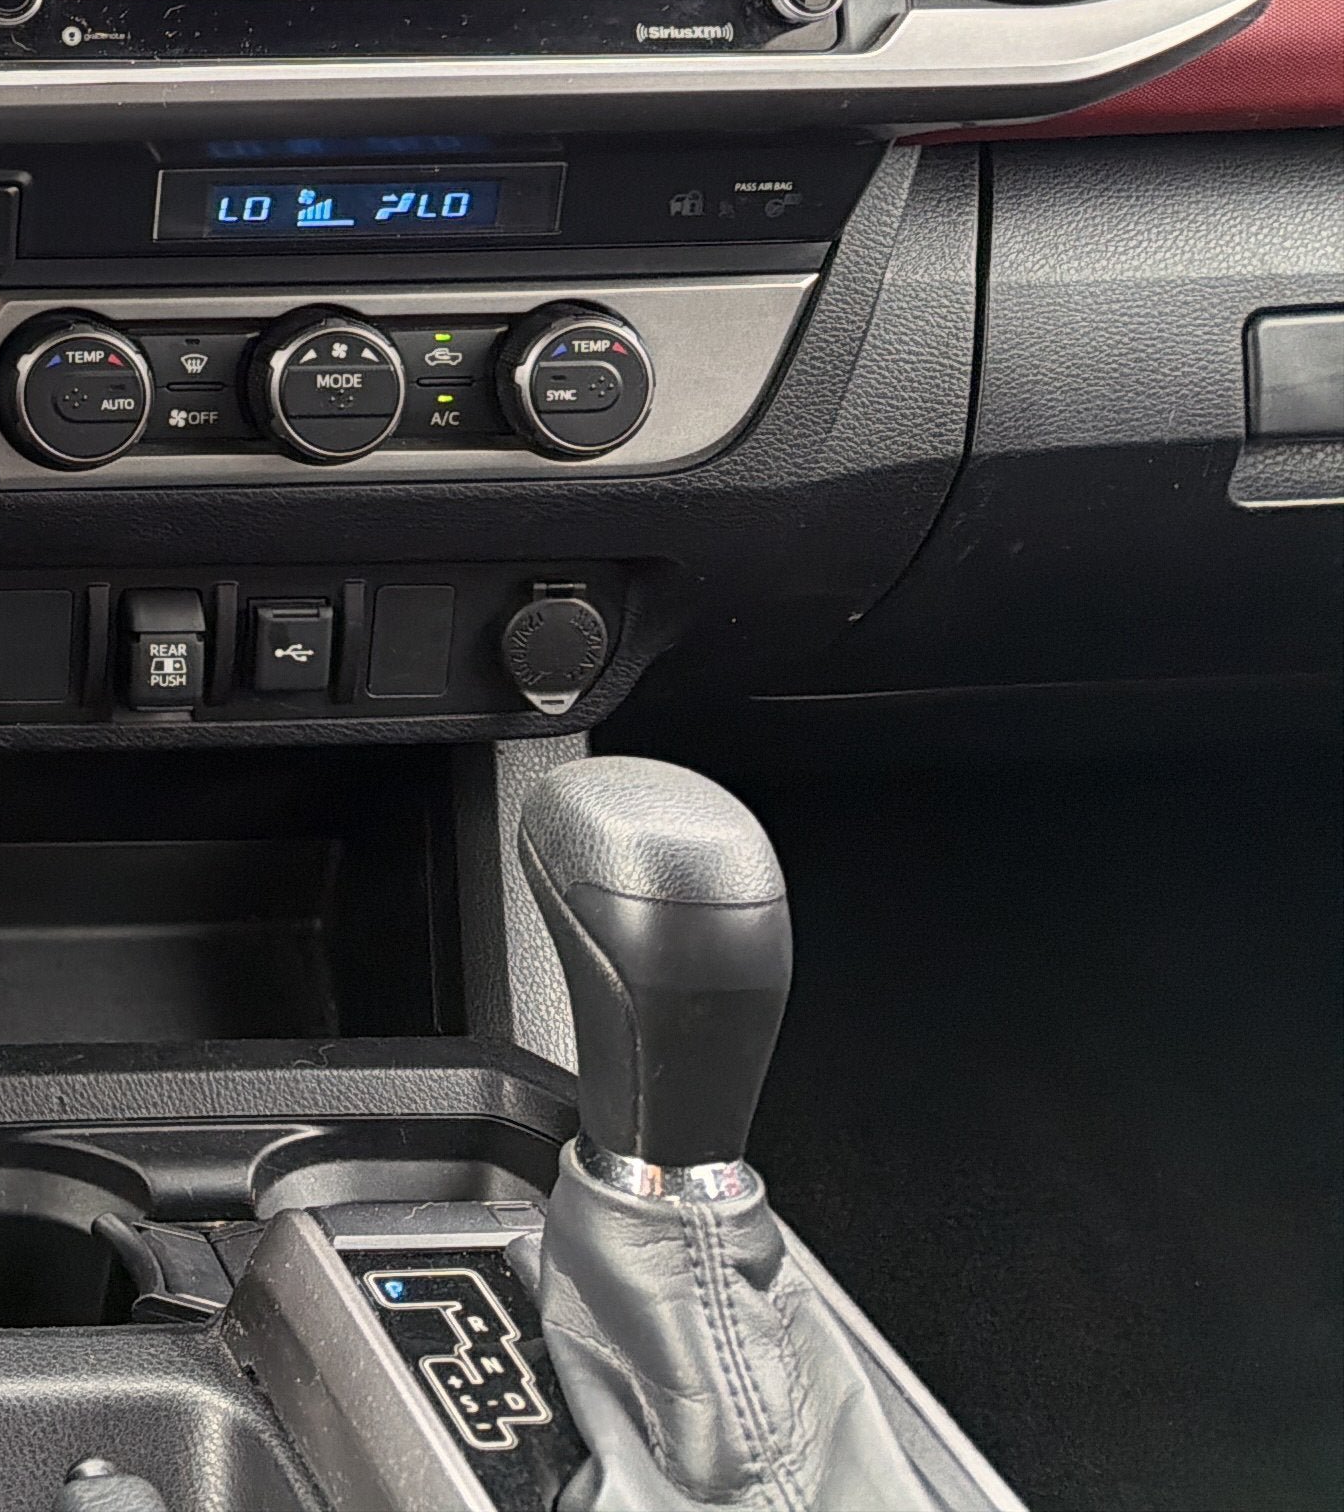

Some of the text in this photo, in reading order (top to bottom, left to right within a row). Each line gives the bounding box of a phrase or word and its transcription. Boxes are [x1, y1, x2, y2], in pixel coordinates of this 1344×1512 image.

[734, 182, 793, 192] PASS AIR BAG
[572, 340, 611, 353] TEMP
[65, 351, 105, 364] TEMP
[316, 373, 363, 389] MODE
[546, 390, 578, 401] SYNC
[100, 399, 135, 411] AUTO
[188, 411, 219, 425] OFF
[430, 411, 460, 427] A/C
[150, 643, 187, 657] REAR
[150, 675, 186, 687] PUSH
[467, 1316, 489, 1332] R
[480, 1357, 504, 1374] N
[459, 1394, 479, 1413] S
[503, 1392, 526, 1410] D
